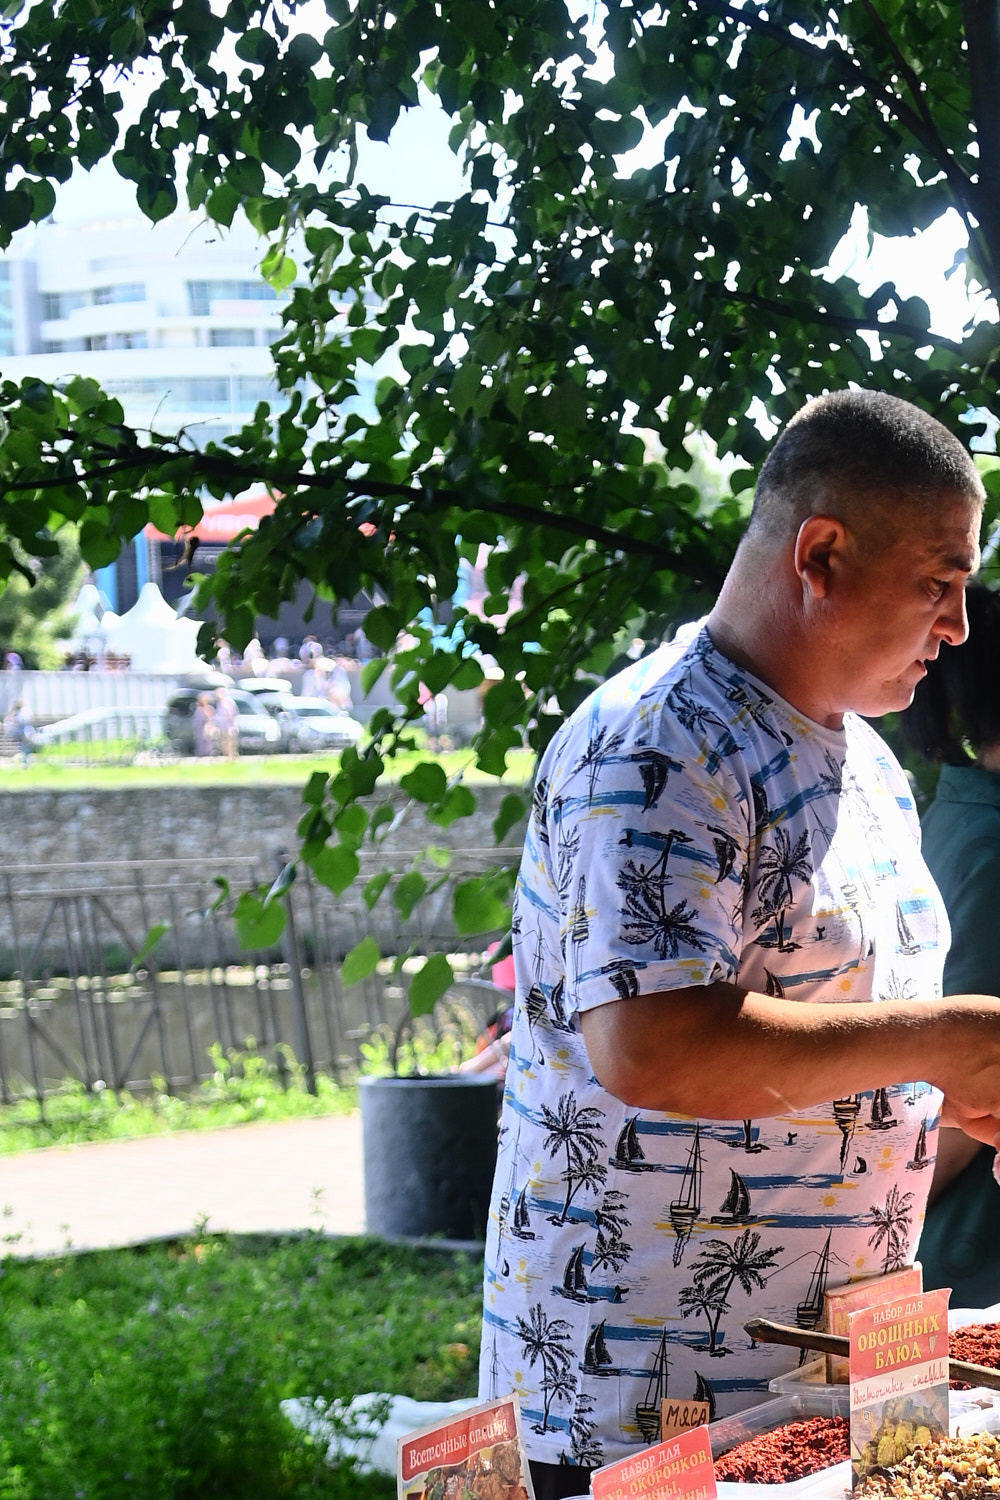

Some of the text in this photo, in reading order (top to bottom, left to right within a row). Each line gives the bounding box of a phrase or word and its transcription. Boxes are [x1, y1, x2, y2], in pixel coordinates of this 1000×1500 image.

[873, 1301, 923, 1324] НАБОР ДЛЯ
[857, 1314, 940, 1352] ОВОЩНЫХ
[875, 1341, 922, 1370] БЛЮД
[665, 1405, 707, 1428] МЯСА
[409, 1418, 508, 1470] Восточные специи
[621, 1443, 681, 1480] НАБОР ДЛЯ
[630, 1449, 711, 1495] ОКОРОЧКОВ,
